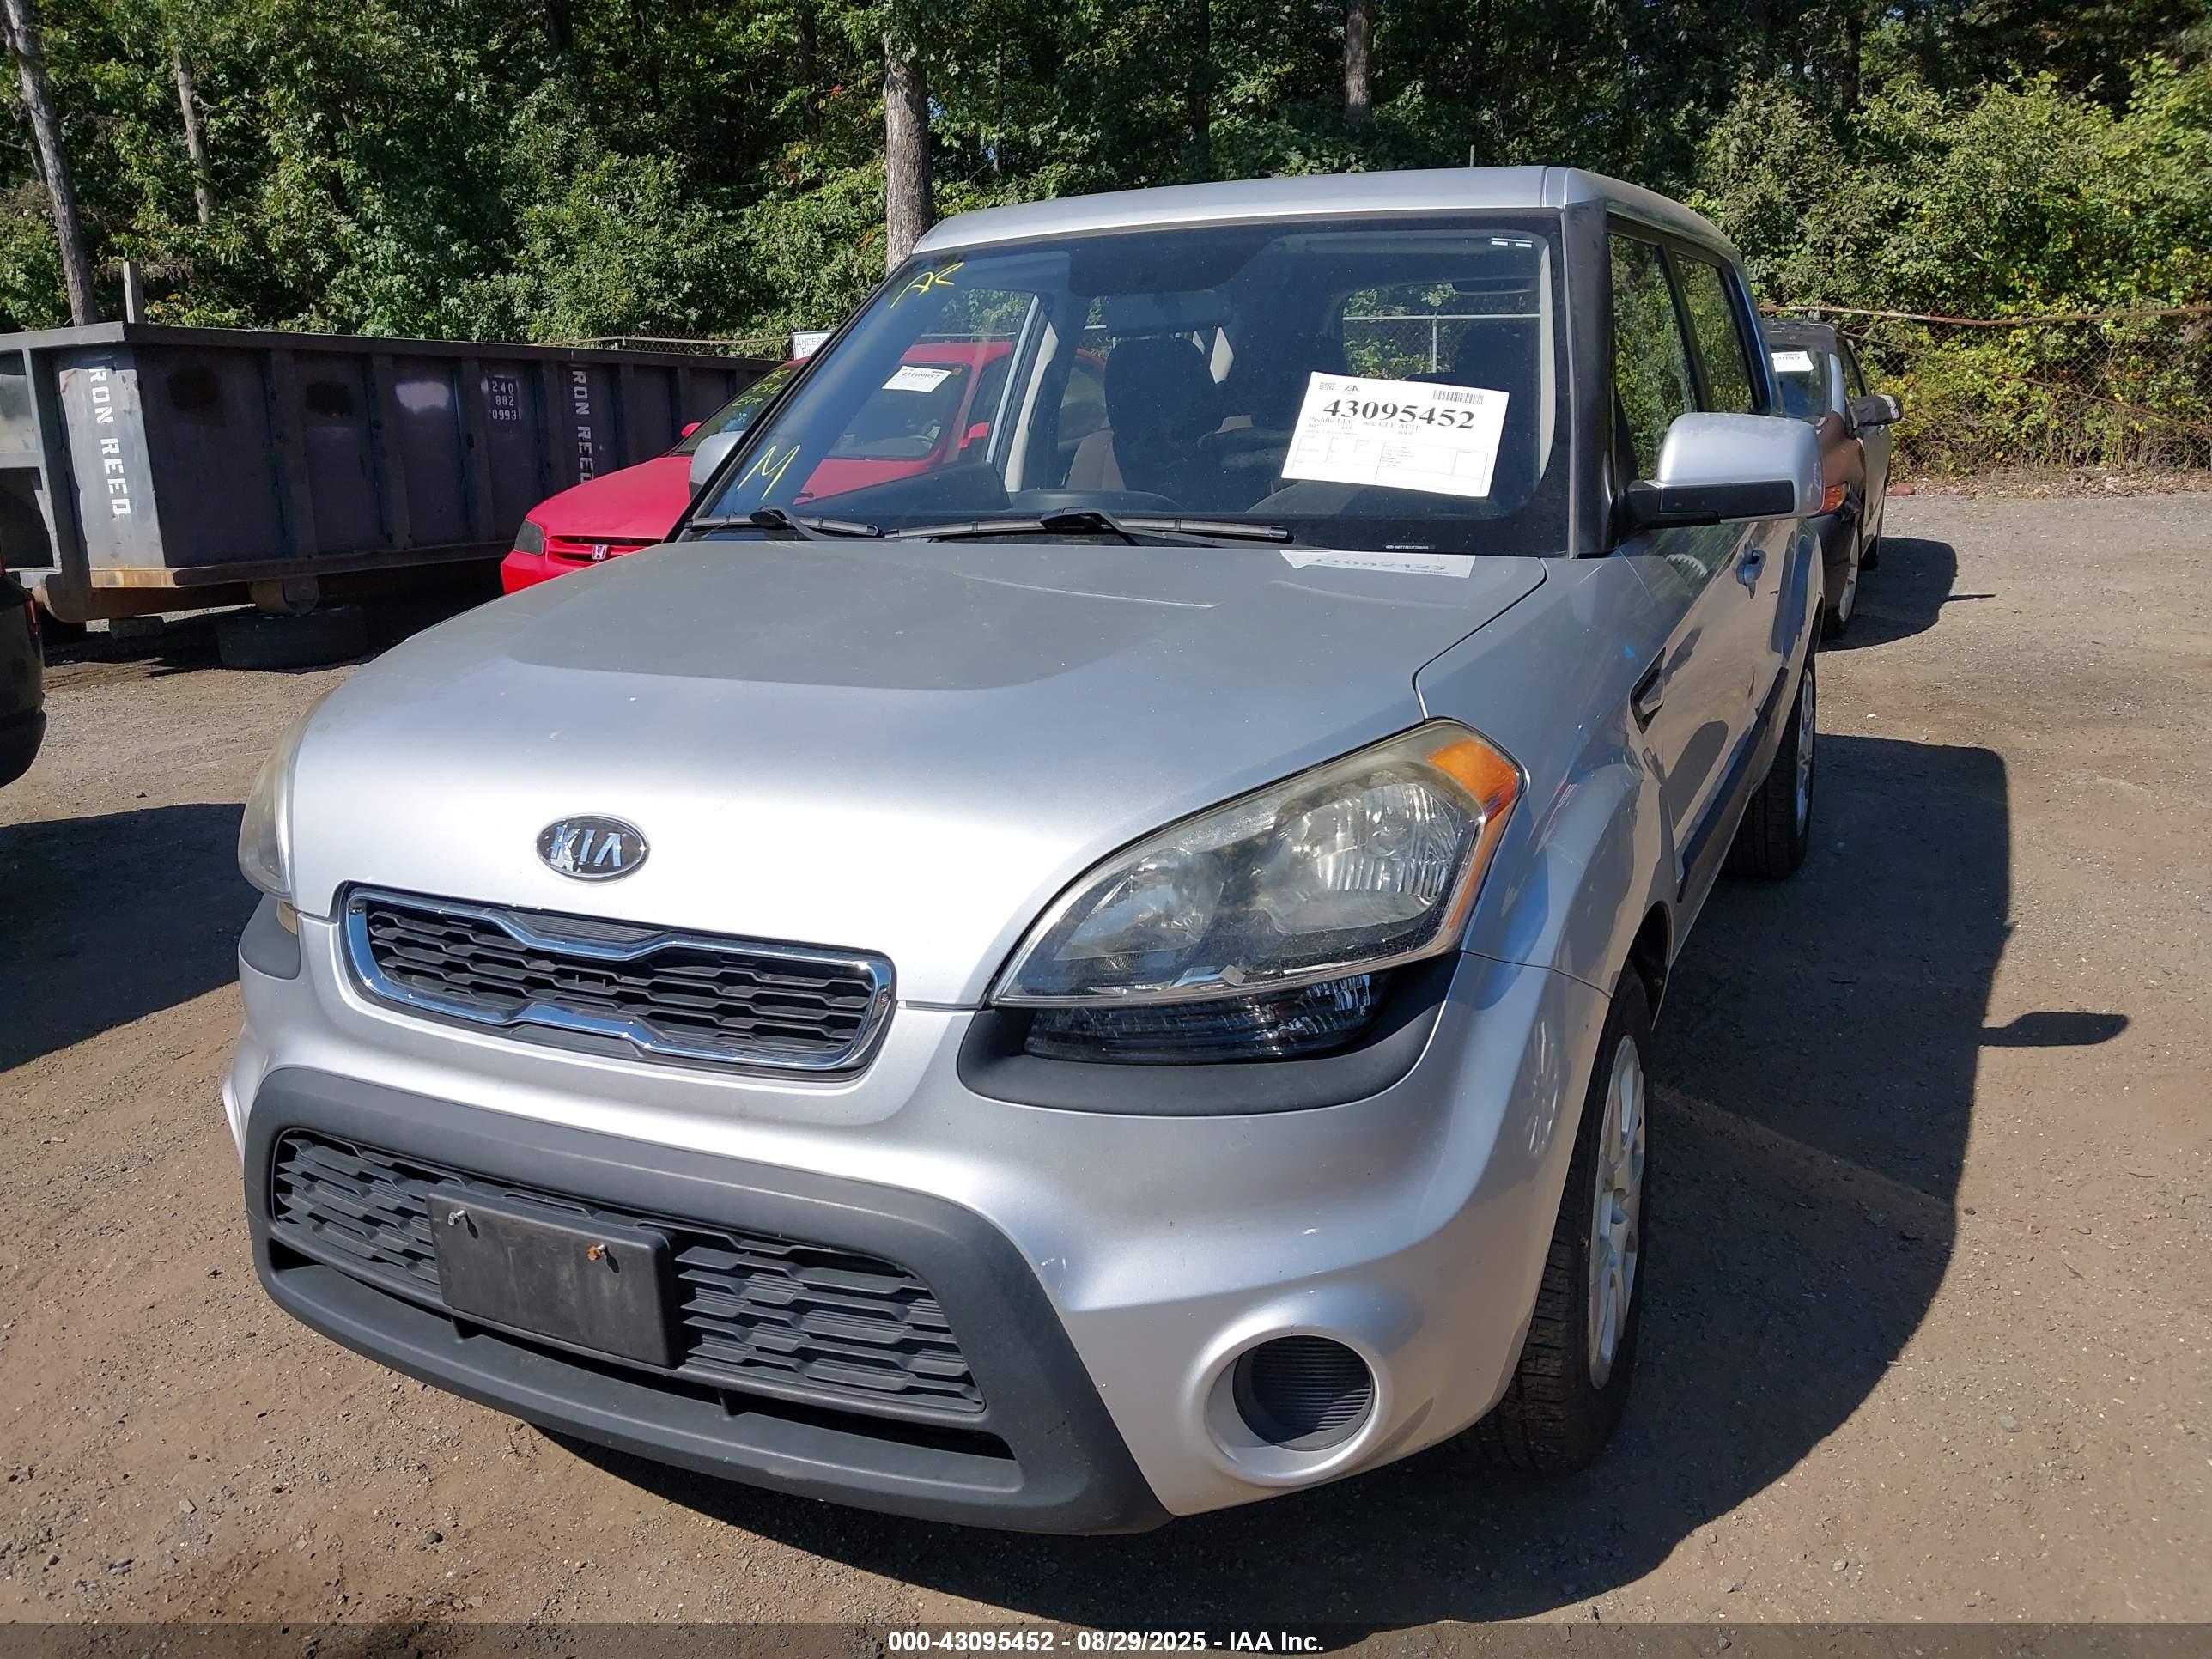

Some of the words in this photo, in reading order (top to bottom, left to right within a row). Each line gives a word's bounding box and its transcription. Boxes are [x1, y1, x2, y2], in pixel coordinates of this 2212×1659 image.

[492, 409, 517, 420] 0993
[1323, 398, 1475, 430] 43095452
[100, 437, 131, 520] REED
[737, 444, 801, 501] M
[550, 825, 622, 867] KIA
